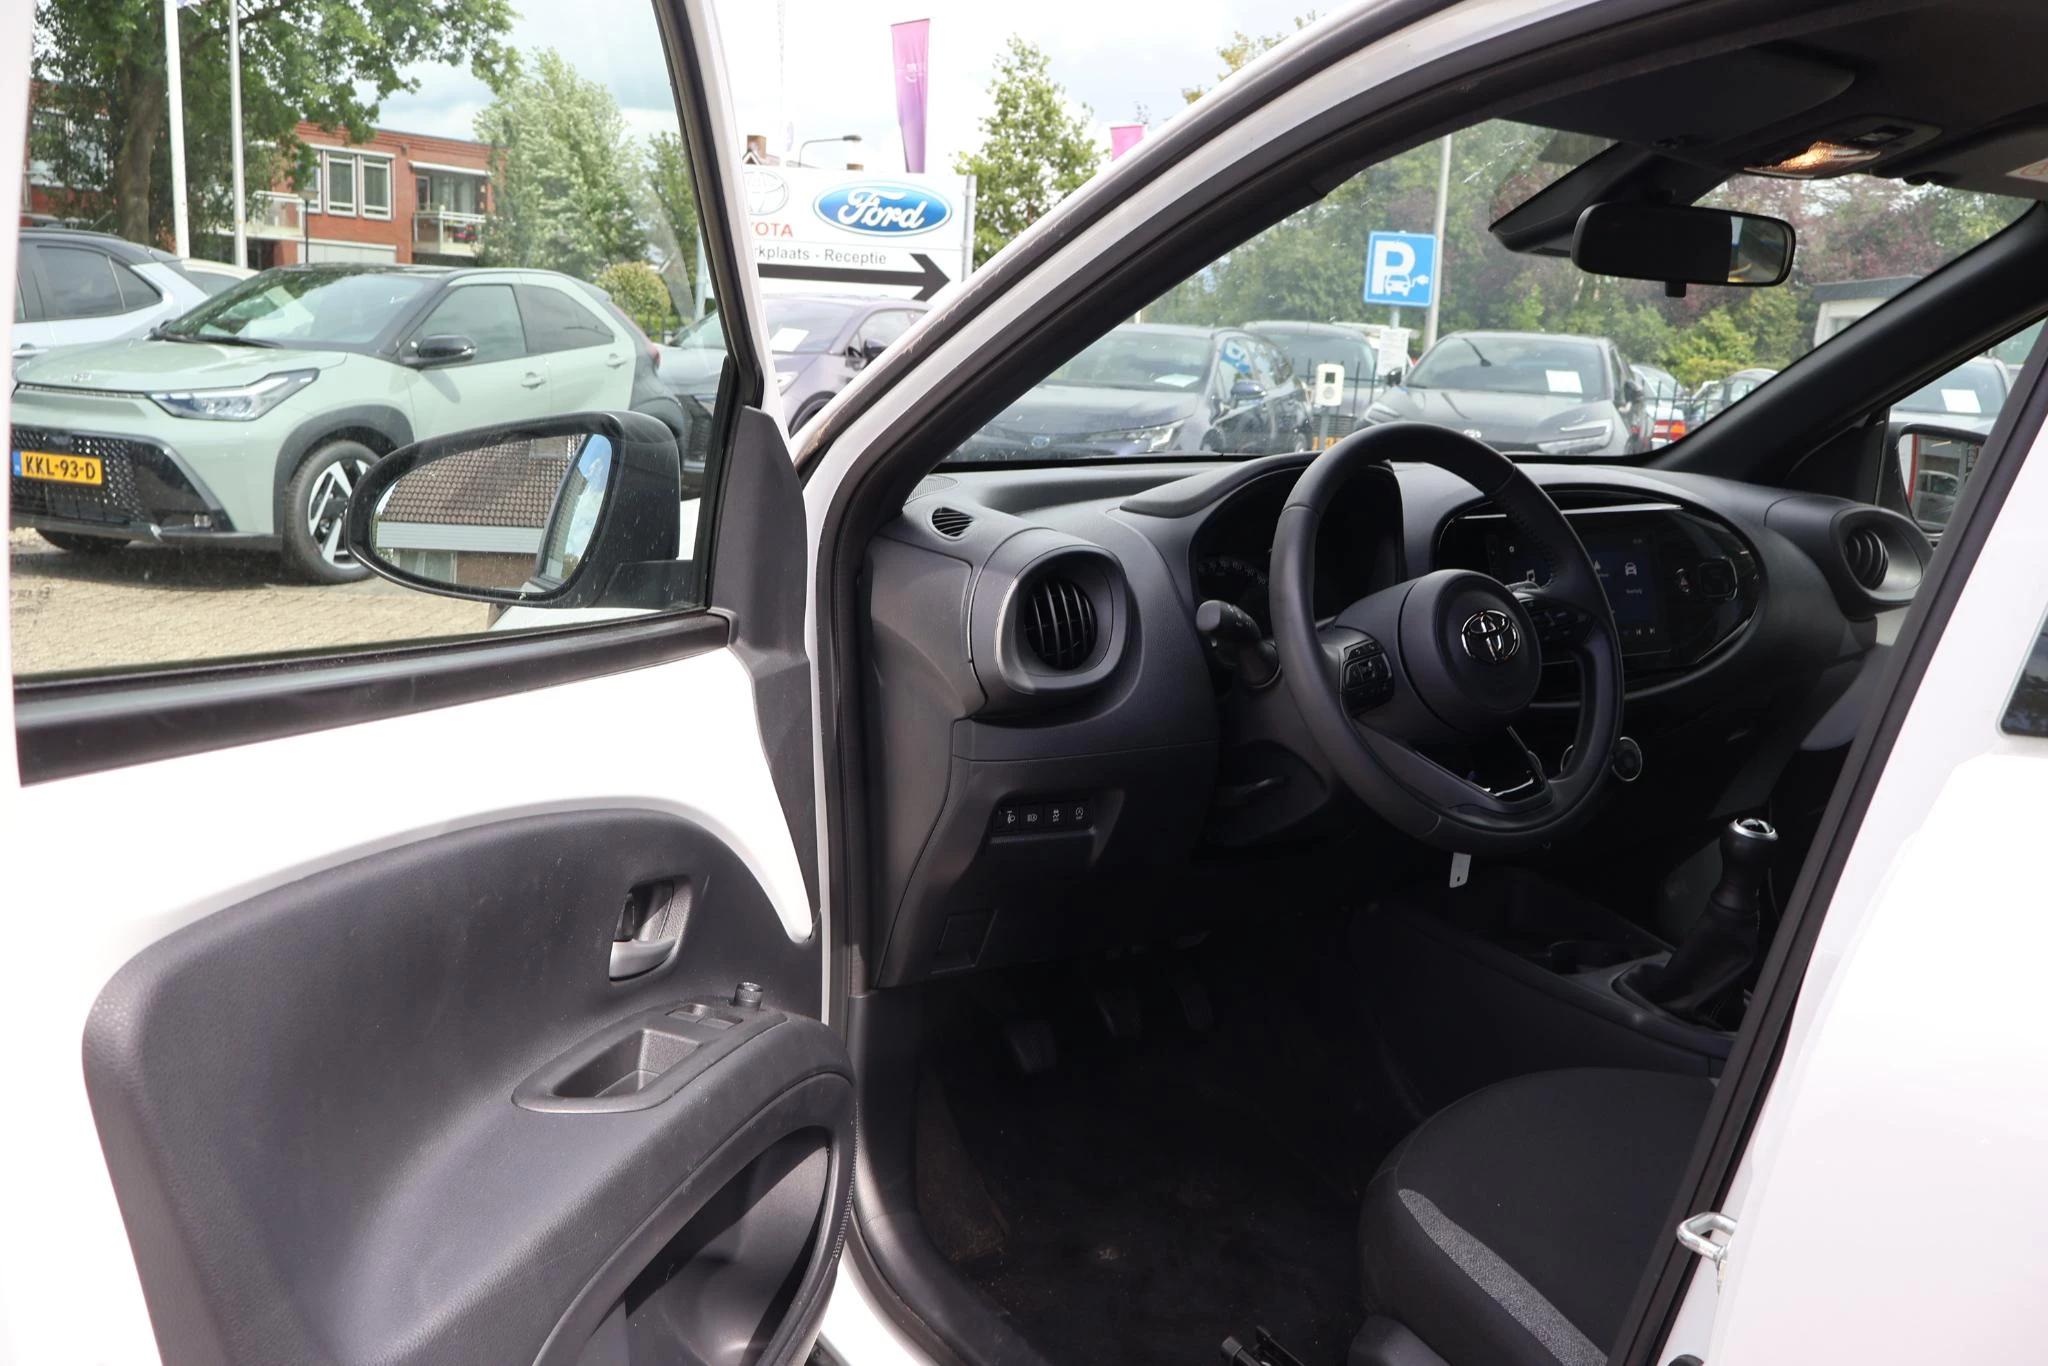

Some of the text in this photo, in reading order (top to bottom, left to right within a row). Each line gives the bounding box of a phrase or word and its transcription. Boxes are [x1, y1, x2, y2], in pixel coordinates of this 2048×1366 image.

[837, 188, 927, 229] Ford
[752, 222, 793, 238] OTA
[824, 248, 887, 265] Receptie
[1371, 240, 1416, 296] P
[25, 456, 96, 480] KKL-93-D
